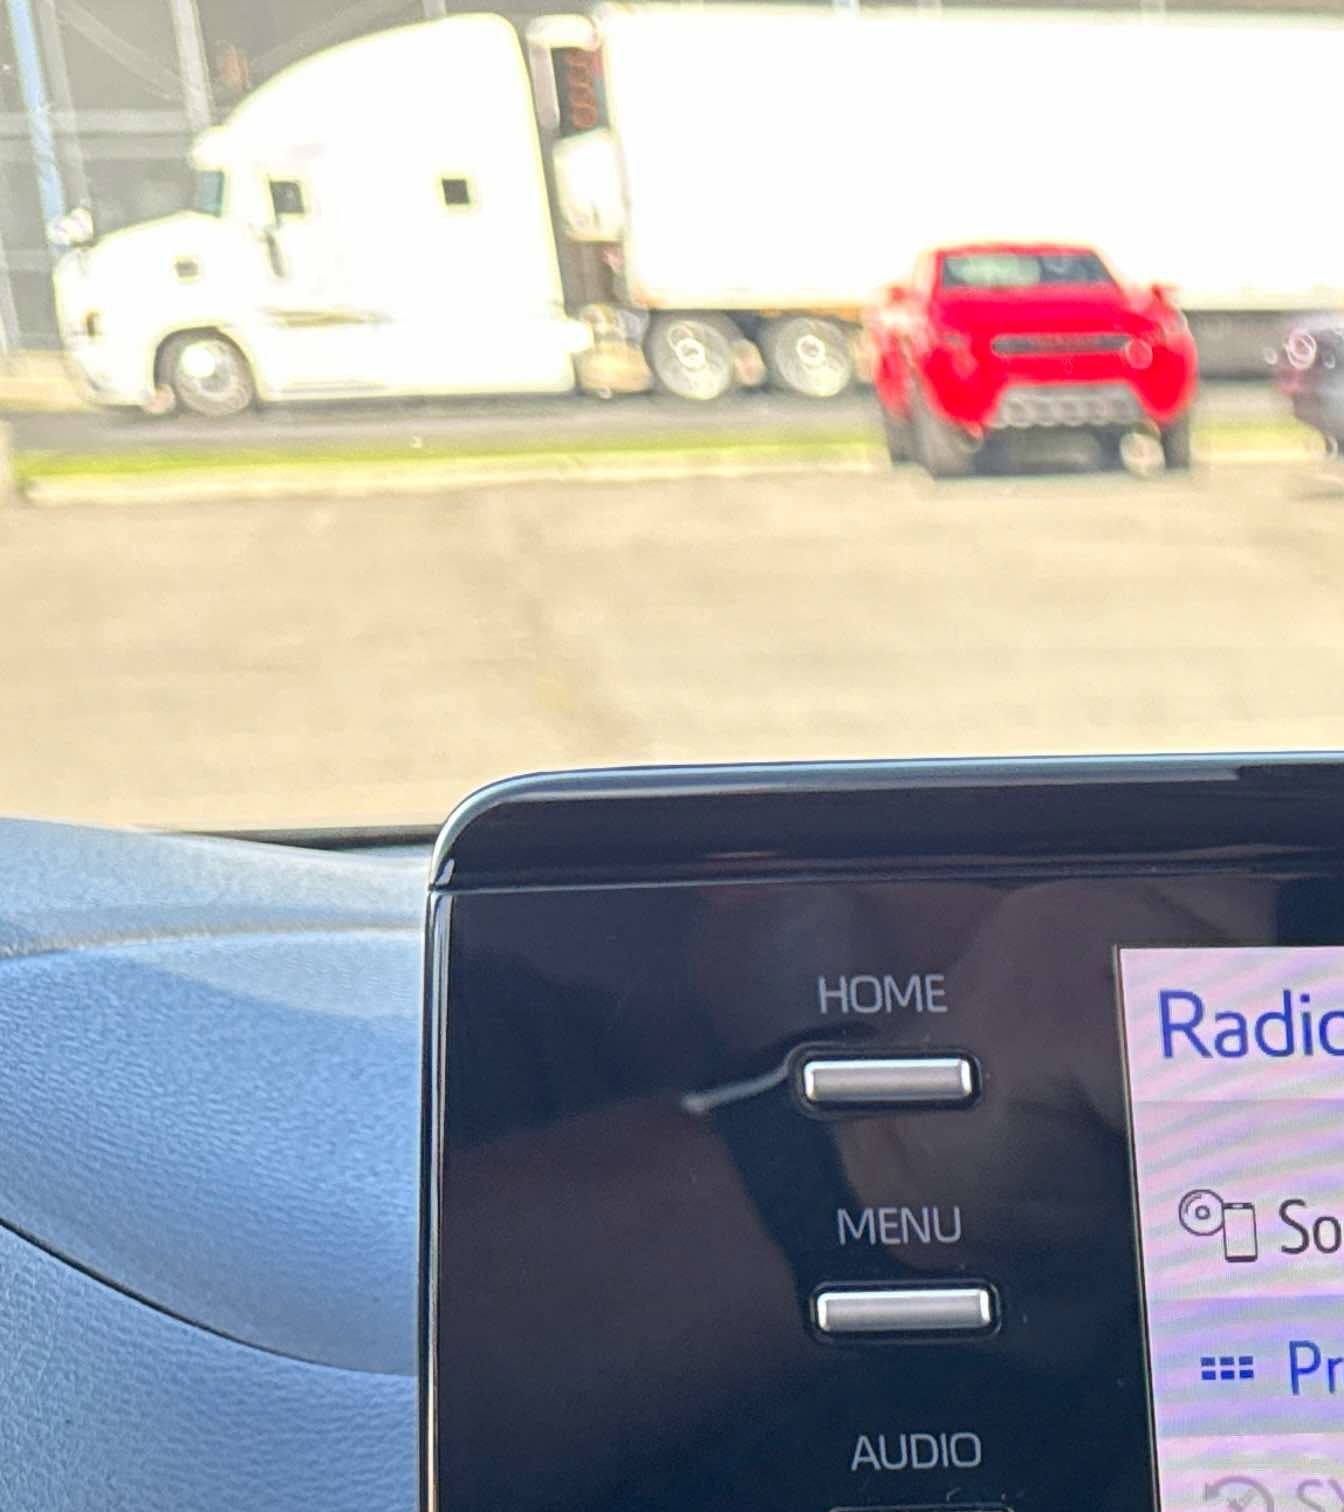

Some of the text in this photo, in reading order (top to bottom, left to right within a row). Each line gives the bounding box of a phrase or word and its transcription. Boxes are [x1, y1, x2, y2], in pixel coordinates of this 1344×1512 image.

[818, 974, 948, 1015] HOME
[836, 1206, 963, 1245] MENU
[850, 1431, 983, 1471] AUDIO
